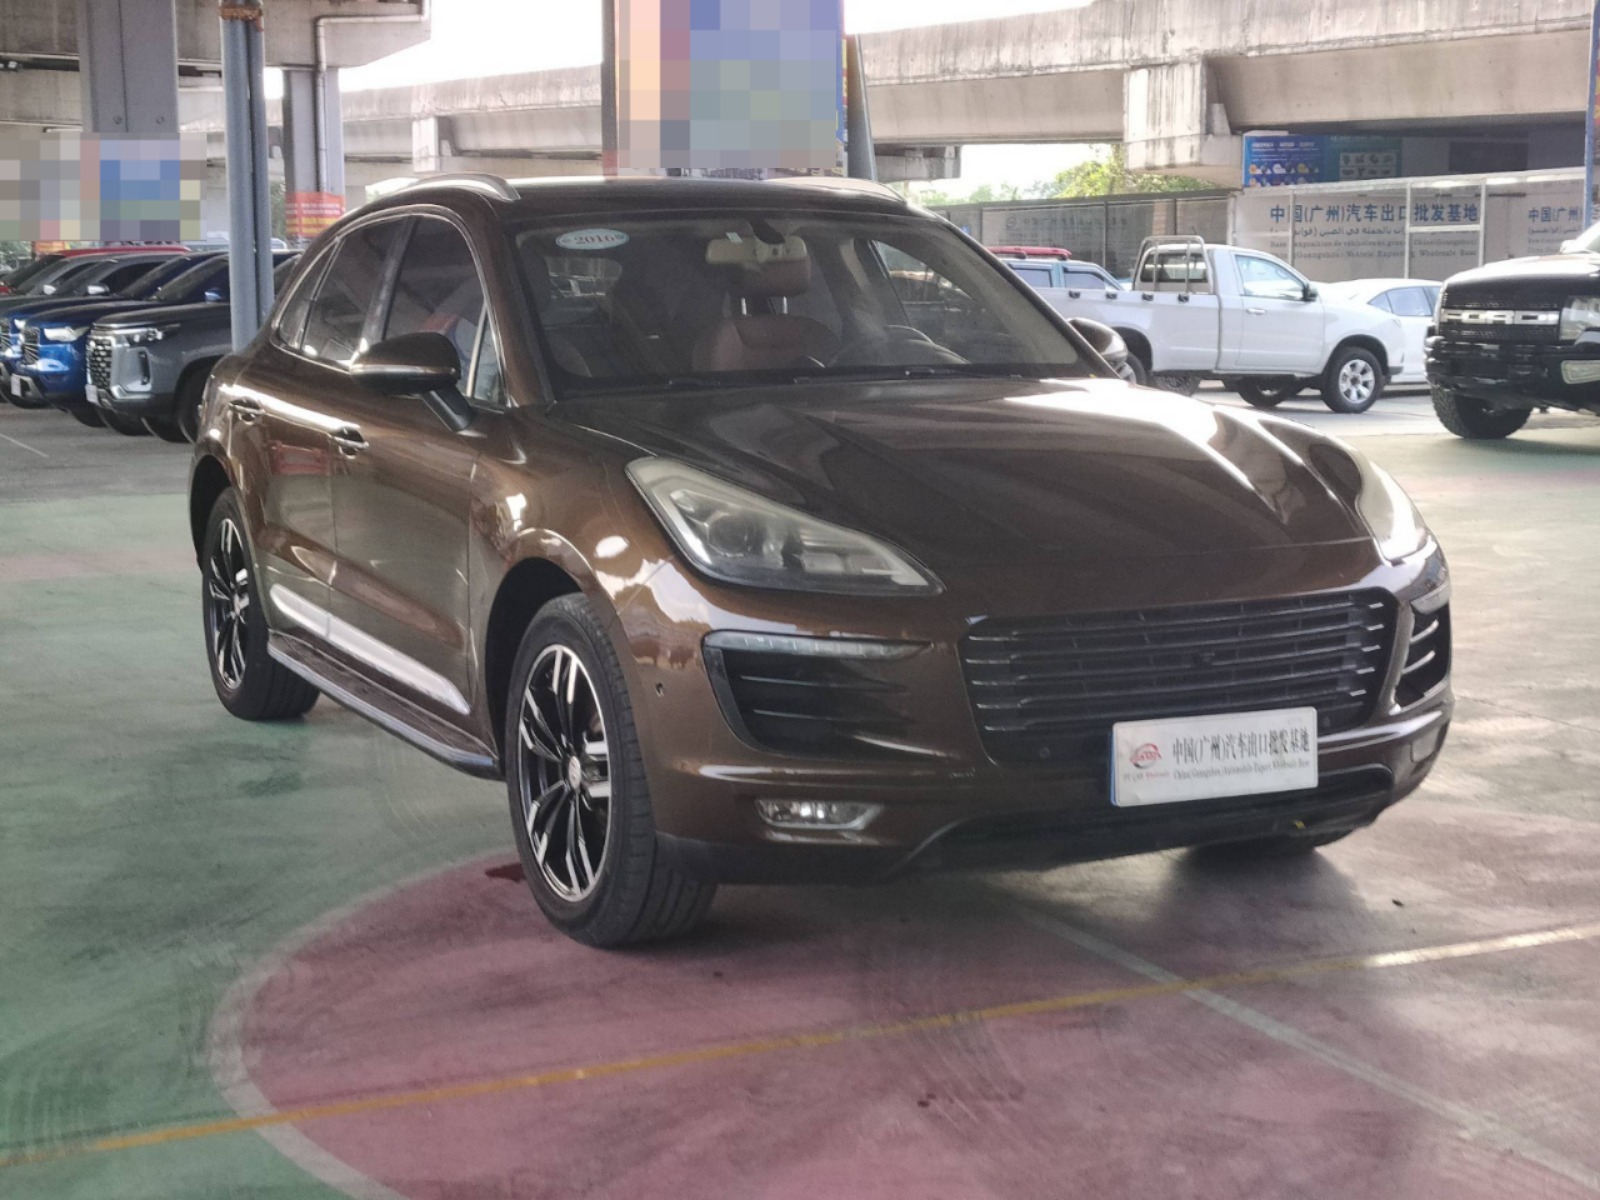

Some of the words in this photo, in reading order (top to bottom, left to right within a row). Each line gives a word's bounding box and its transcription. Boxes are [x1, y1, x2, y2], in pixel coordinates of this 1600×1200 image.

[1270, 203, 1478, 222] 中国(广州)汽车出口批发基地
[574, 234, 616, 245] 2016
[1172, 727, 1310, 765] 中国(广州)汽车出口批发基地
